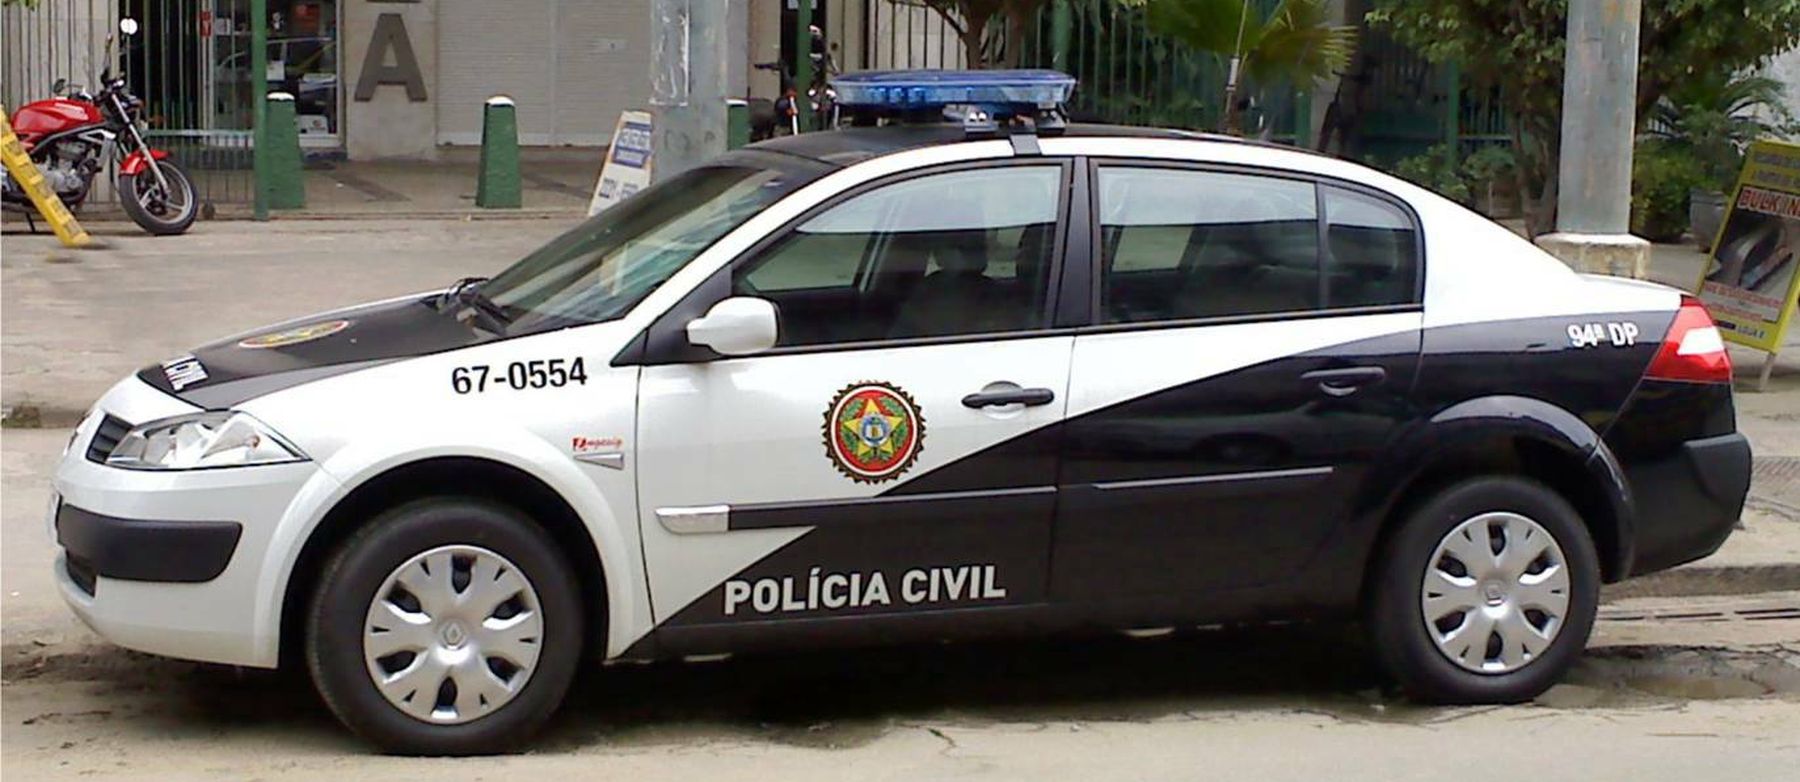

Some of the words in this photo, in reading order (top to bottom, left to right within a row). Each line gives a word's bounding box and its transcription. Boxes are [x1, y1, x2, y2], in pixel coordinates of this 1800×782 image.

[1607, 322, 1638, 346] DP
[451, 356, 588, 395] 67-0554
[724, 567, 892, 615] POLÍCIA
[901, 565, 1007, 603] CIVIL
